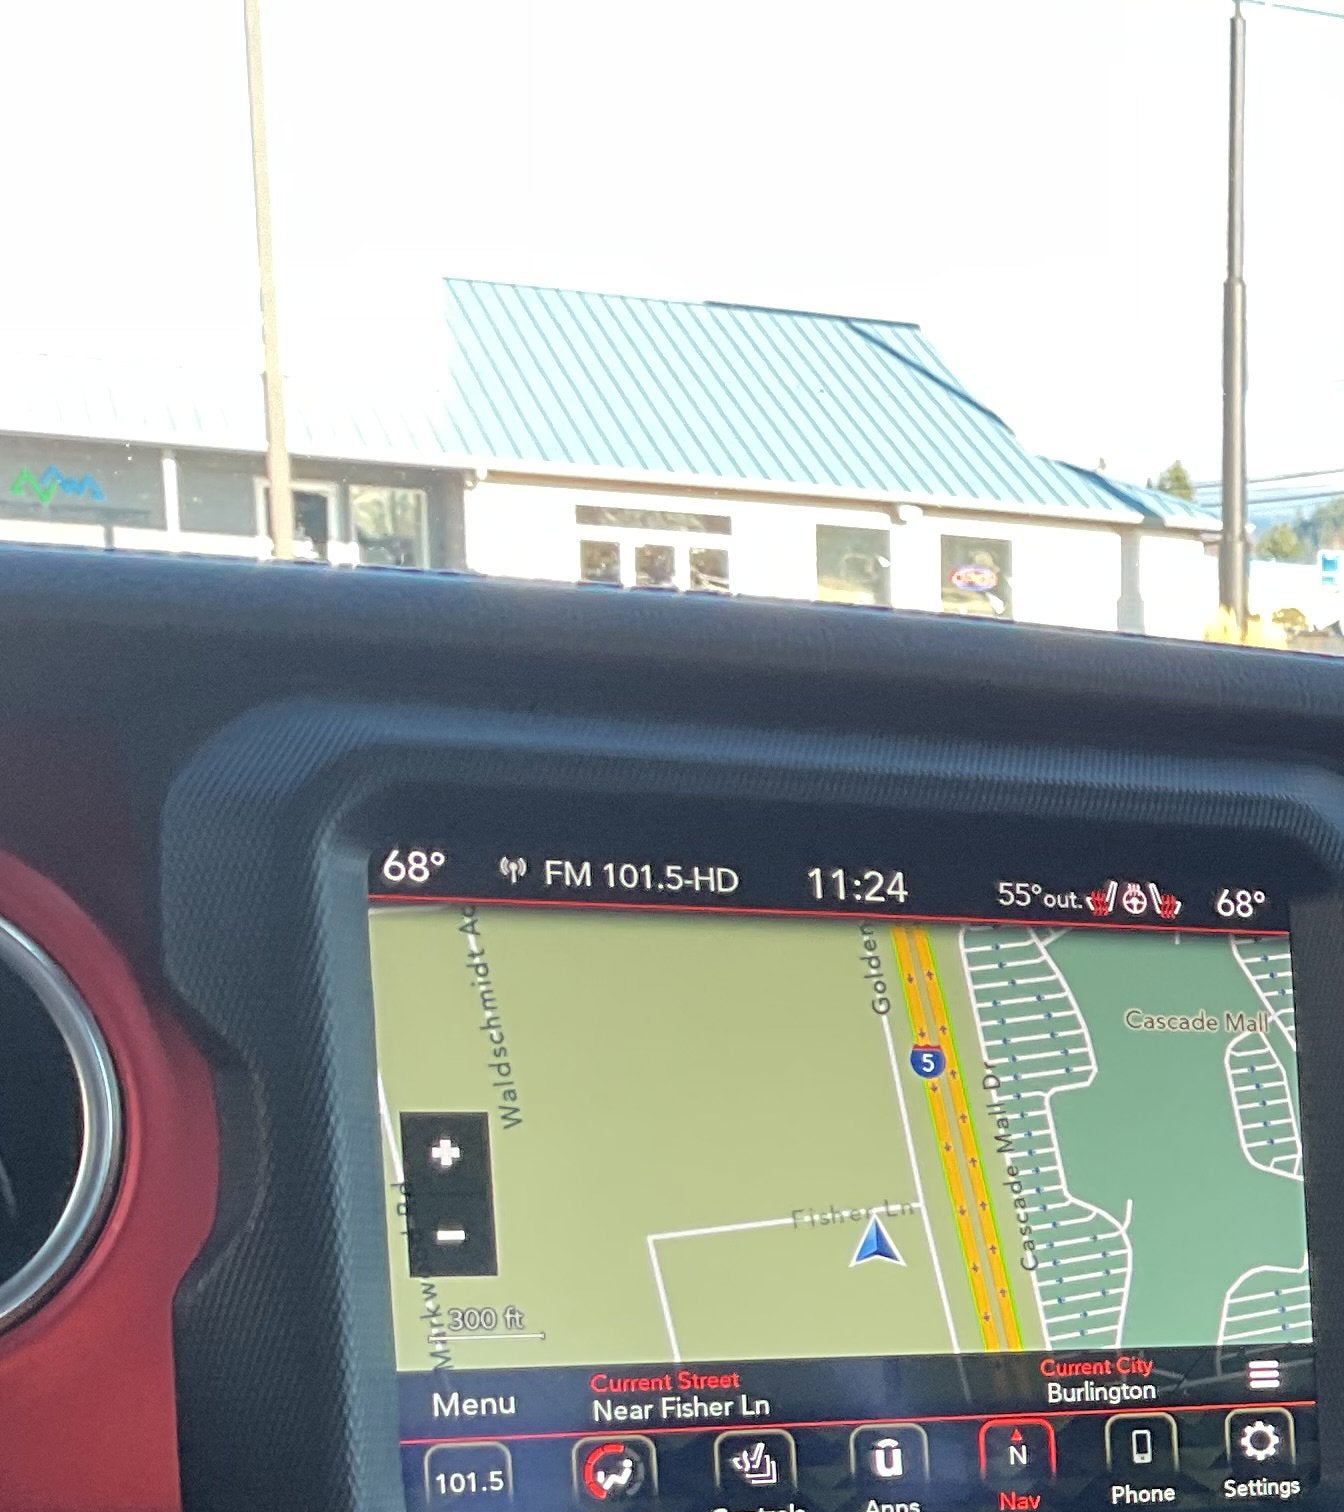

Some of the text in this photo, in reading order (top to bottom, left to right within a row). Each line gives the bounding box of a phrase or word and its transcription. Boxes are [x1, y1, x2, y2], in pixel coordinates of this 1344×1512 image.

[383, 850, 446, 883] 68°
[544, 860, 740, 894] FM 101.5-HD
[808, 868, 908, 902] 11:24
[1216, 888, 1266, 918] 68°
[1124, 1010, 1271, 1034] Cascade Mall
[466, 948, 523, 1130] Waldschmidt
[921, 1053, 935, 1072] 5
[983, 1061, 1039, 1271] Cascade Mall Dr
[791, 1198, 915, 1229] Fisher Ln
[447, 1304, 526, 1332] 300 ft
[1039, 1356, 1154, 1379] Current City
[588, 1370, 741, 1394] Current Street
[1047, 1381, 1157, 1405] Burlington
[432, 1392, 517, 1419] Menu
[592, 1394, 770, 1422] Near Fisher Ln
[434, 1471, 505, 1495] 101.5
[1111, 1483, 1177, 1505] Phone
[1224, 1476, 1302, 1501] Settings
[999, 1490, 1041, 1512] Nav
